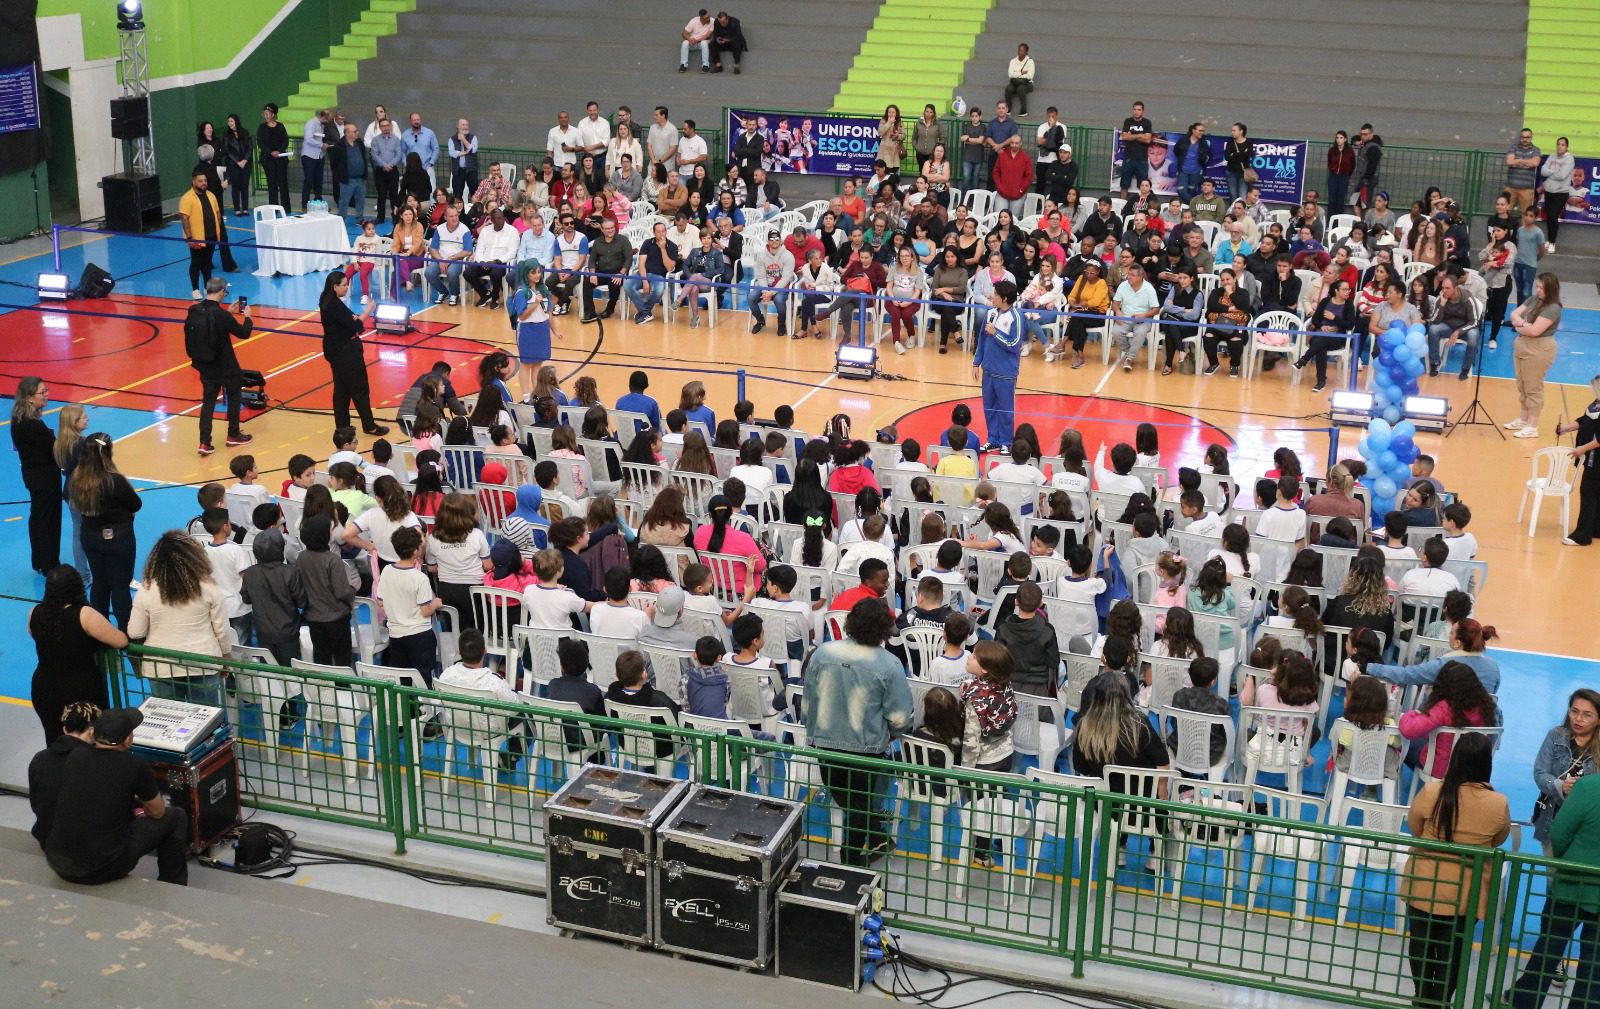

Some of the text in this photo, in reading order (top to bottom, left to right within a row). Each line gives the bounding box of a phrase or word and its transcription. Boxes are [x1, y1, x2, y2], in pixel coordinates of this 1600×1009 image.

[818, 123, 880, 139] UNIFORM
[818, 137, 880, 153] ESCOLA
[1275, 169, 1297, 180] 2023
[584, 828, 608, 841] CMC
[612, 896, 641, 908] PS-700
[719, 918, 750, 930] PS-750
